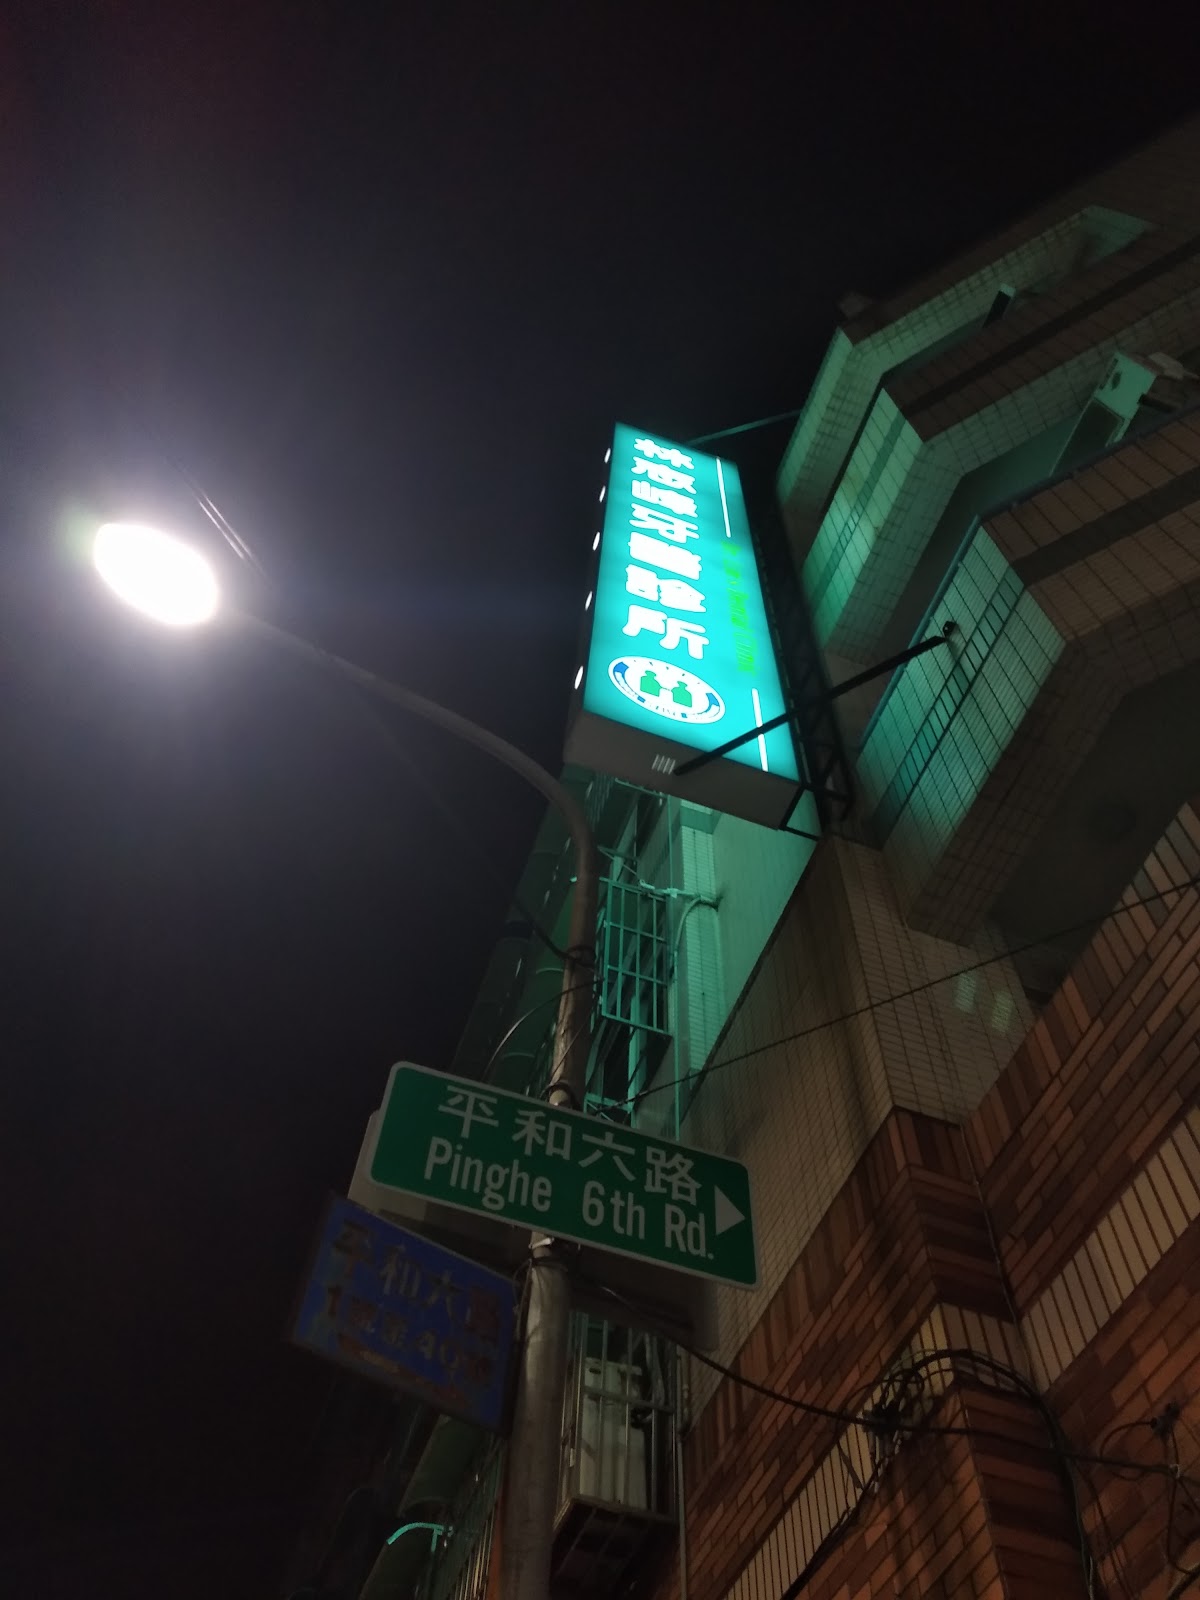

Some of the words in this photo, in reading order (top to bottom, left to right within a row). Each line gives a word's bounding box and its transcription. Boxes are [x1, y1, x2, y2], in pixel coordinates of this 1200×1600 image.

[622, 438, 709, 660] 林志峰牙診所
[424, 1136, 552, 1212] Pinghe
[581, 1180, 645, 1239] 6th
[664, 1203, 715, 1260] Rd.
[438, 1085, 702, 1205] 平和六路
[332, 1220, 501, 1342] 平和六
